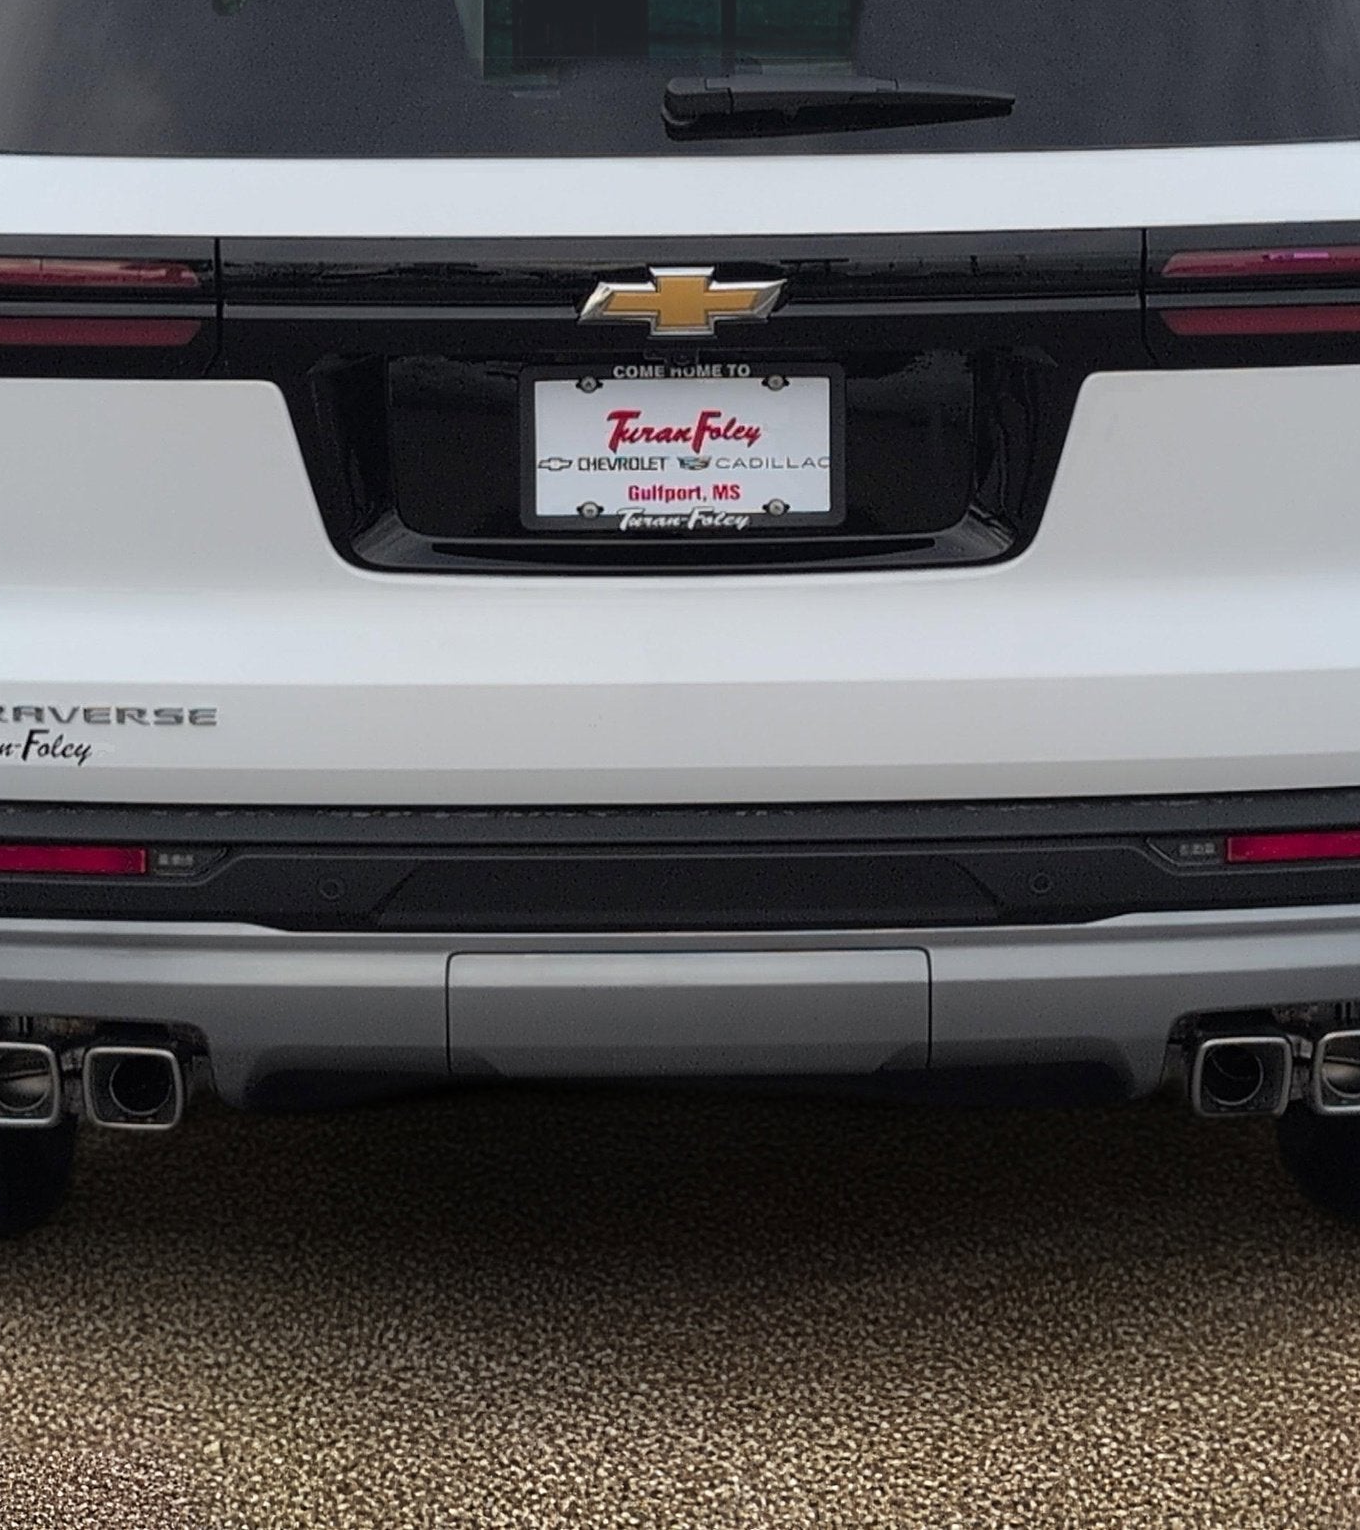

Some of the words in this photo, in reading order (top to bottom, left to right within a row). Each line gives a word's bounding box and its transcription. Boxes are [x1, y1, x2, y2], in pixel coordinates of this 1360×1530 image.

[613, 365, 665, 379] COME
[727, 363, 751, 378] TO
[578, 456, 669, 471] CHEVROLET
[715, 456, 830, 470] CADILLAC
[627, 484, 707, 503] Gulfport,
[712, 484, 741, 500] MS
